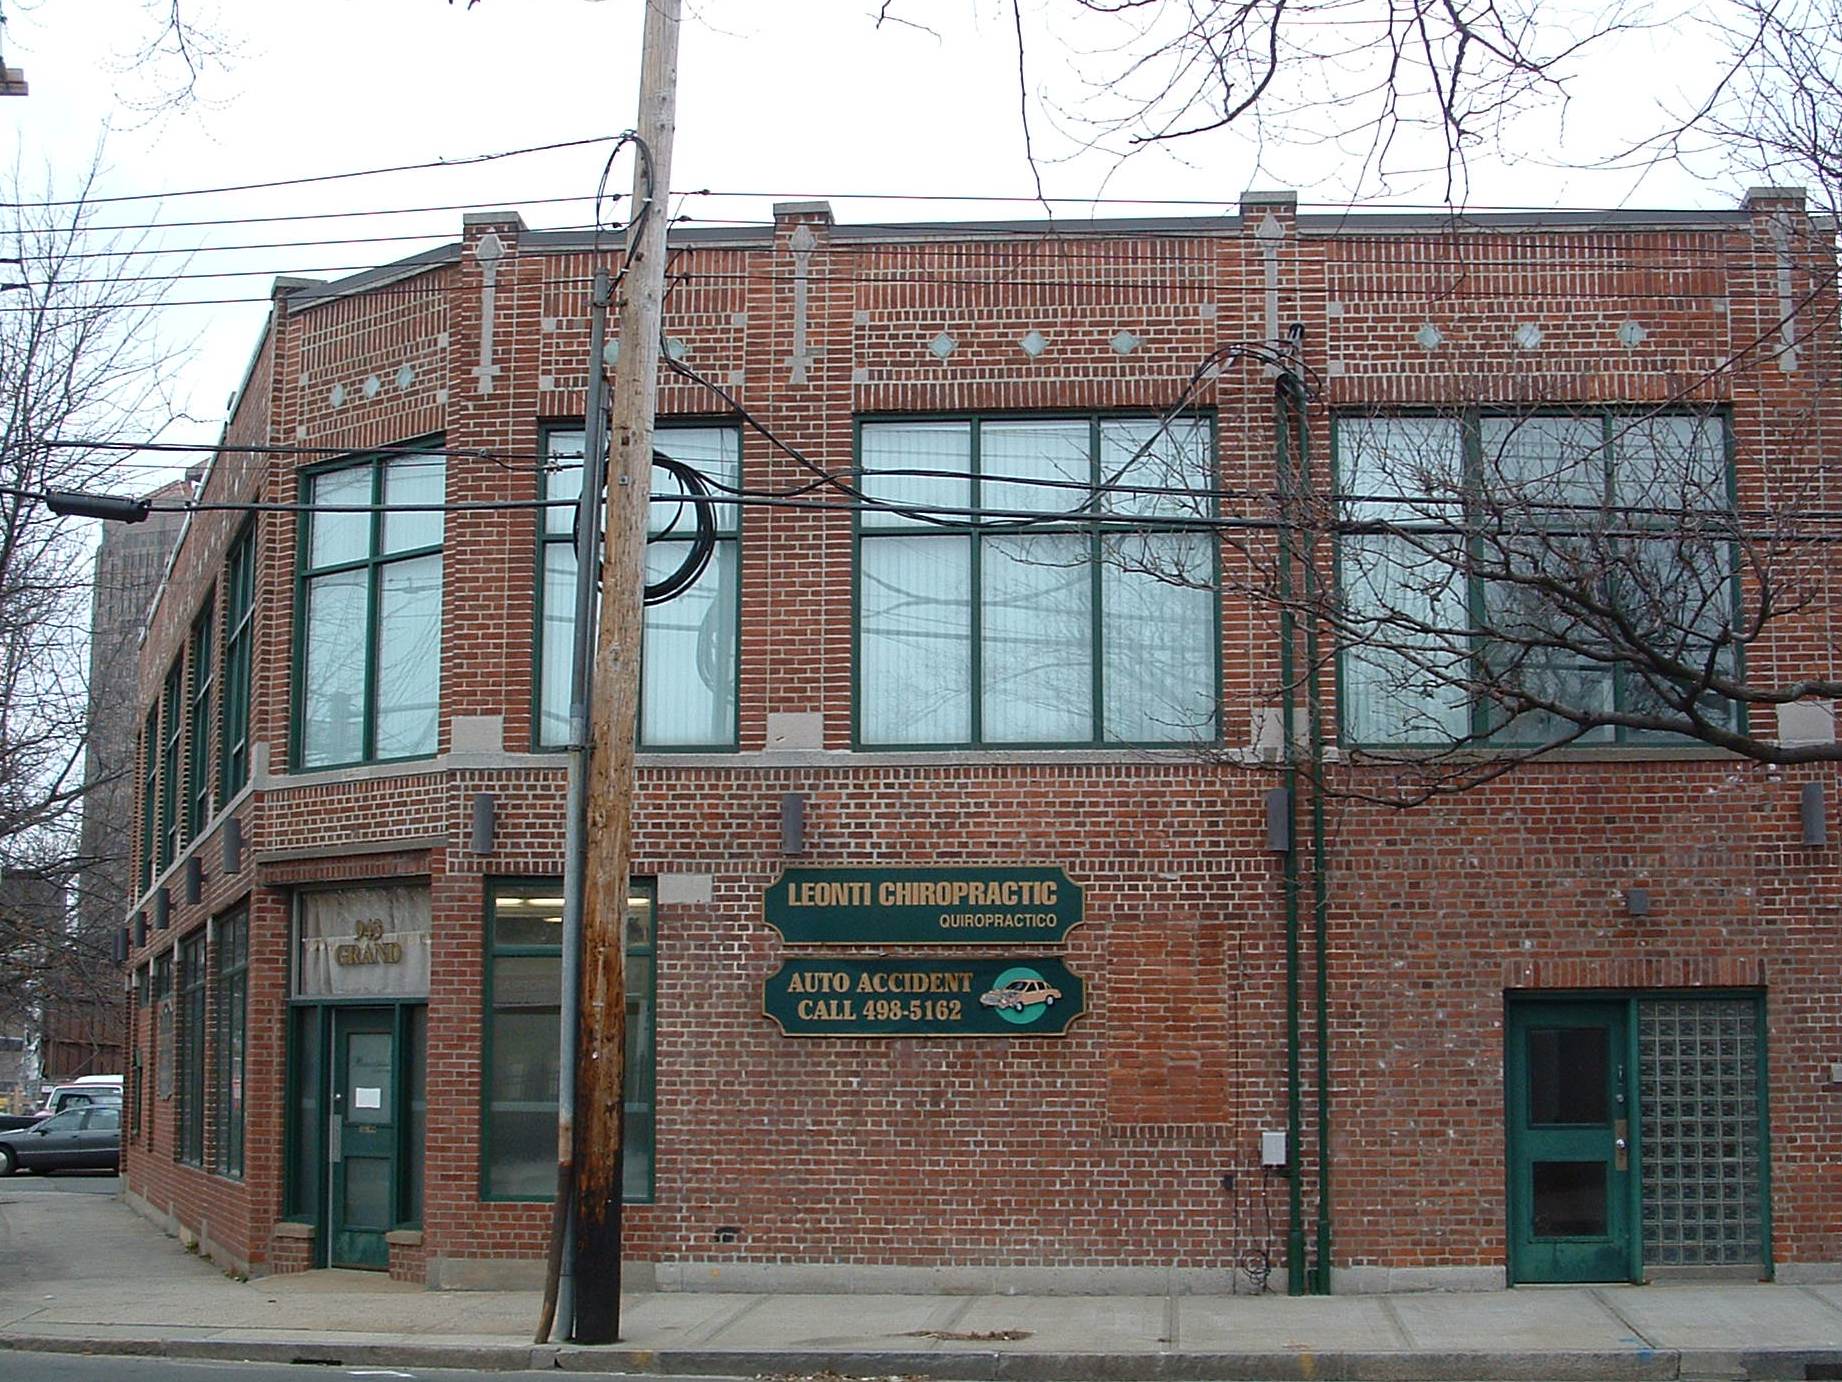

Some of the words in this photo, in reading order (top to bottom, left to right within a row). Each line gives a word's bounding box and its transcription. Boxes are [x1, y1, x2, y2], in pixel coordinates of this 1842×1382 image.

[788, 882, 871, 906] LEONTI
[878, 881, 1058, 906] CHIROPRACTIC
[939, 914, 1057, 928] QUIROPRACTICO
[335, 943, 402, 966] GRAND
[787, 972, 850, 993] AUTO
[856, 972, 973, 993] ACCIDENT
[798, 1000, 857, 1020] CALL
[863, 1000, 962, 1021] 498-5162
